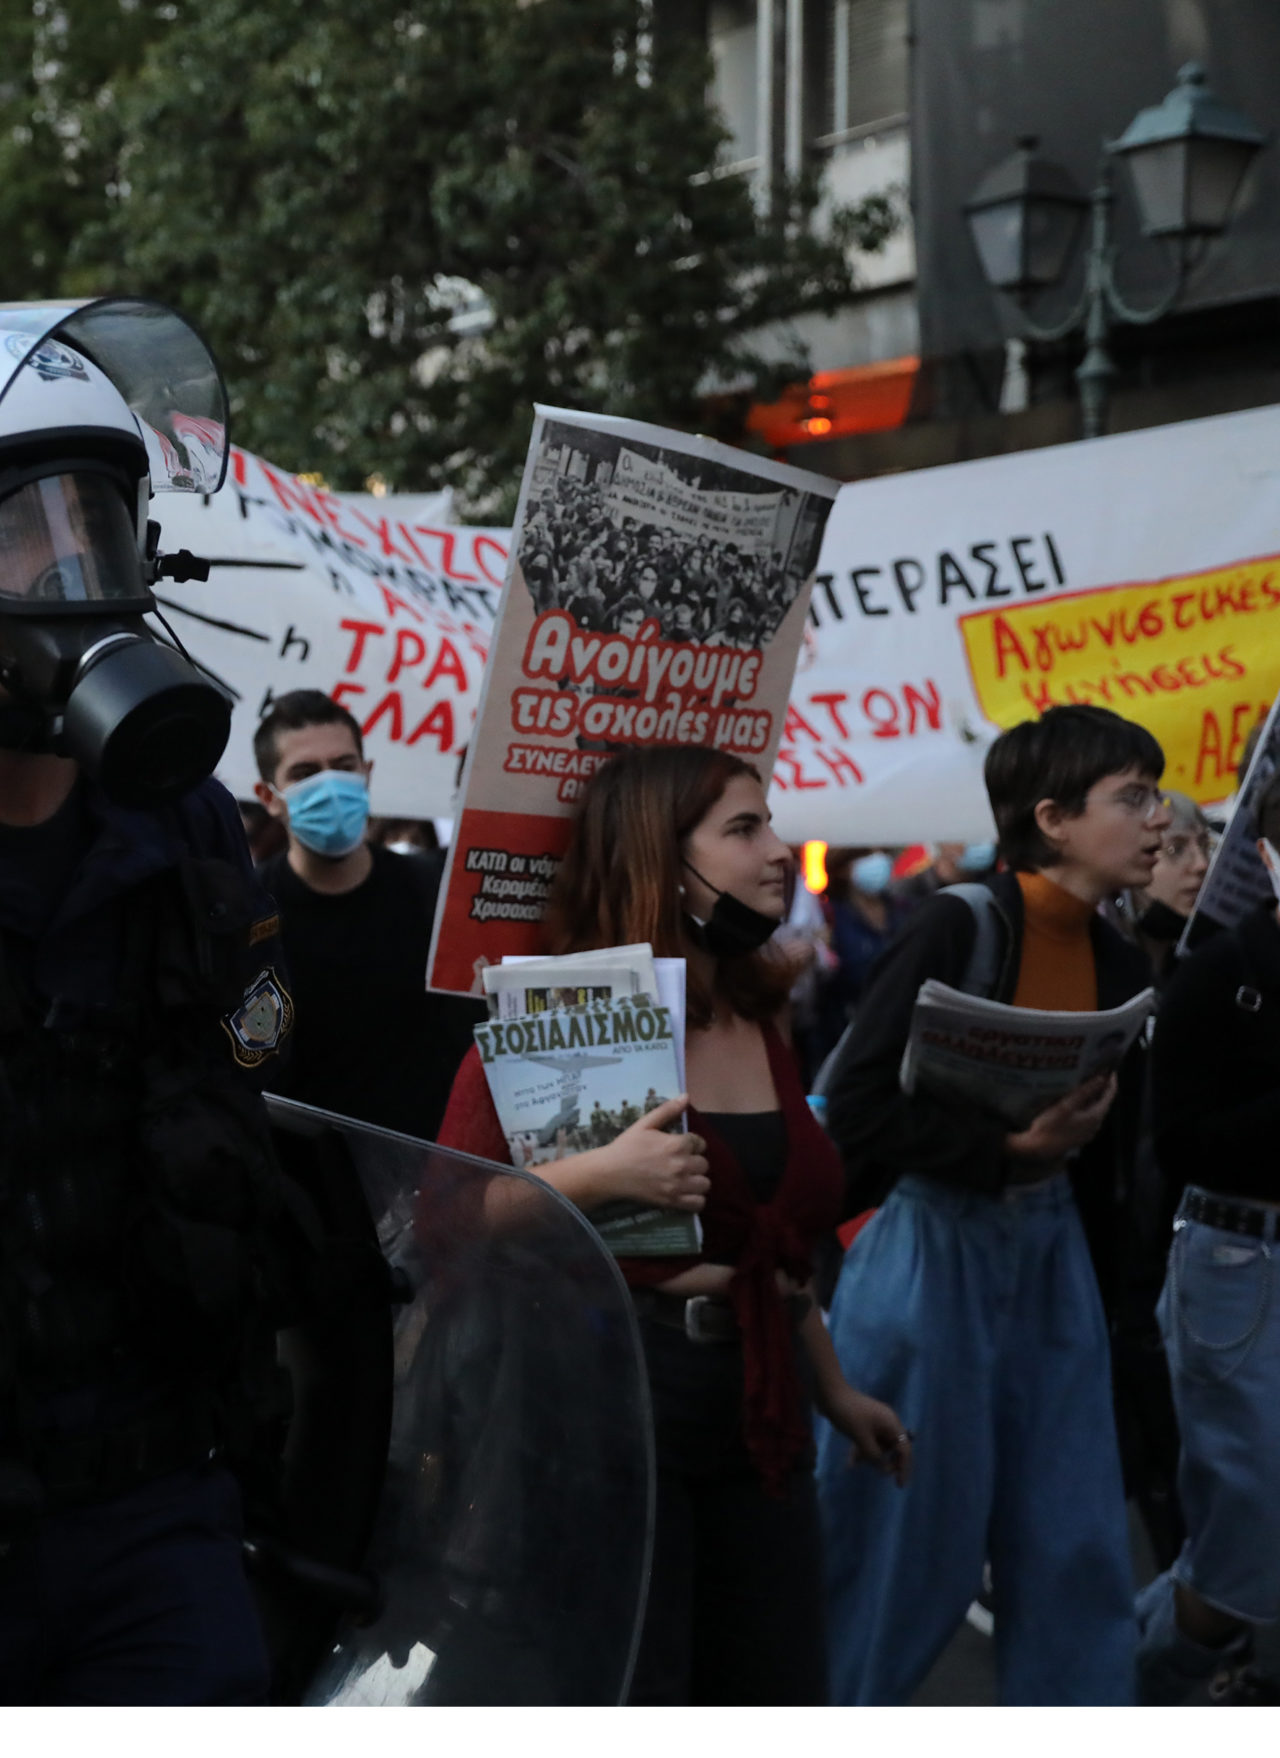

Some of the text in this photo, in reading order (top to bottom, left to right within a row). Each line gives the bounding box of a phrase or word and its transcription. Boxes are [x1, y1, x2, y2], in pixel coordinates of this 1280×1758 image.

[528, 614, 759, 708] Ανοίγουμε
[518, 691, 769, 750] τις σχολές μας
[508, 748, 610, 777] ΣΥΝΕΛΕΥ
[773, 747, 864, 791] ΣΗ
[467, 850, 508, 871] ΚΑΤΩ
[529, 855, 559, 879] νόμ
[491, 1007, 672, 1056] ΣΟΣΙΑΛΙΣΜΟΣ
